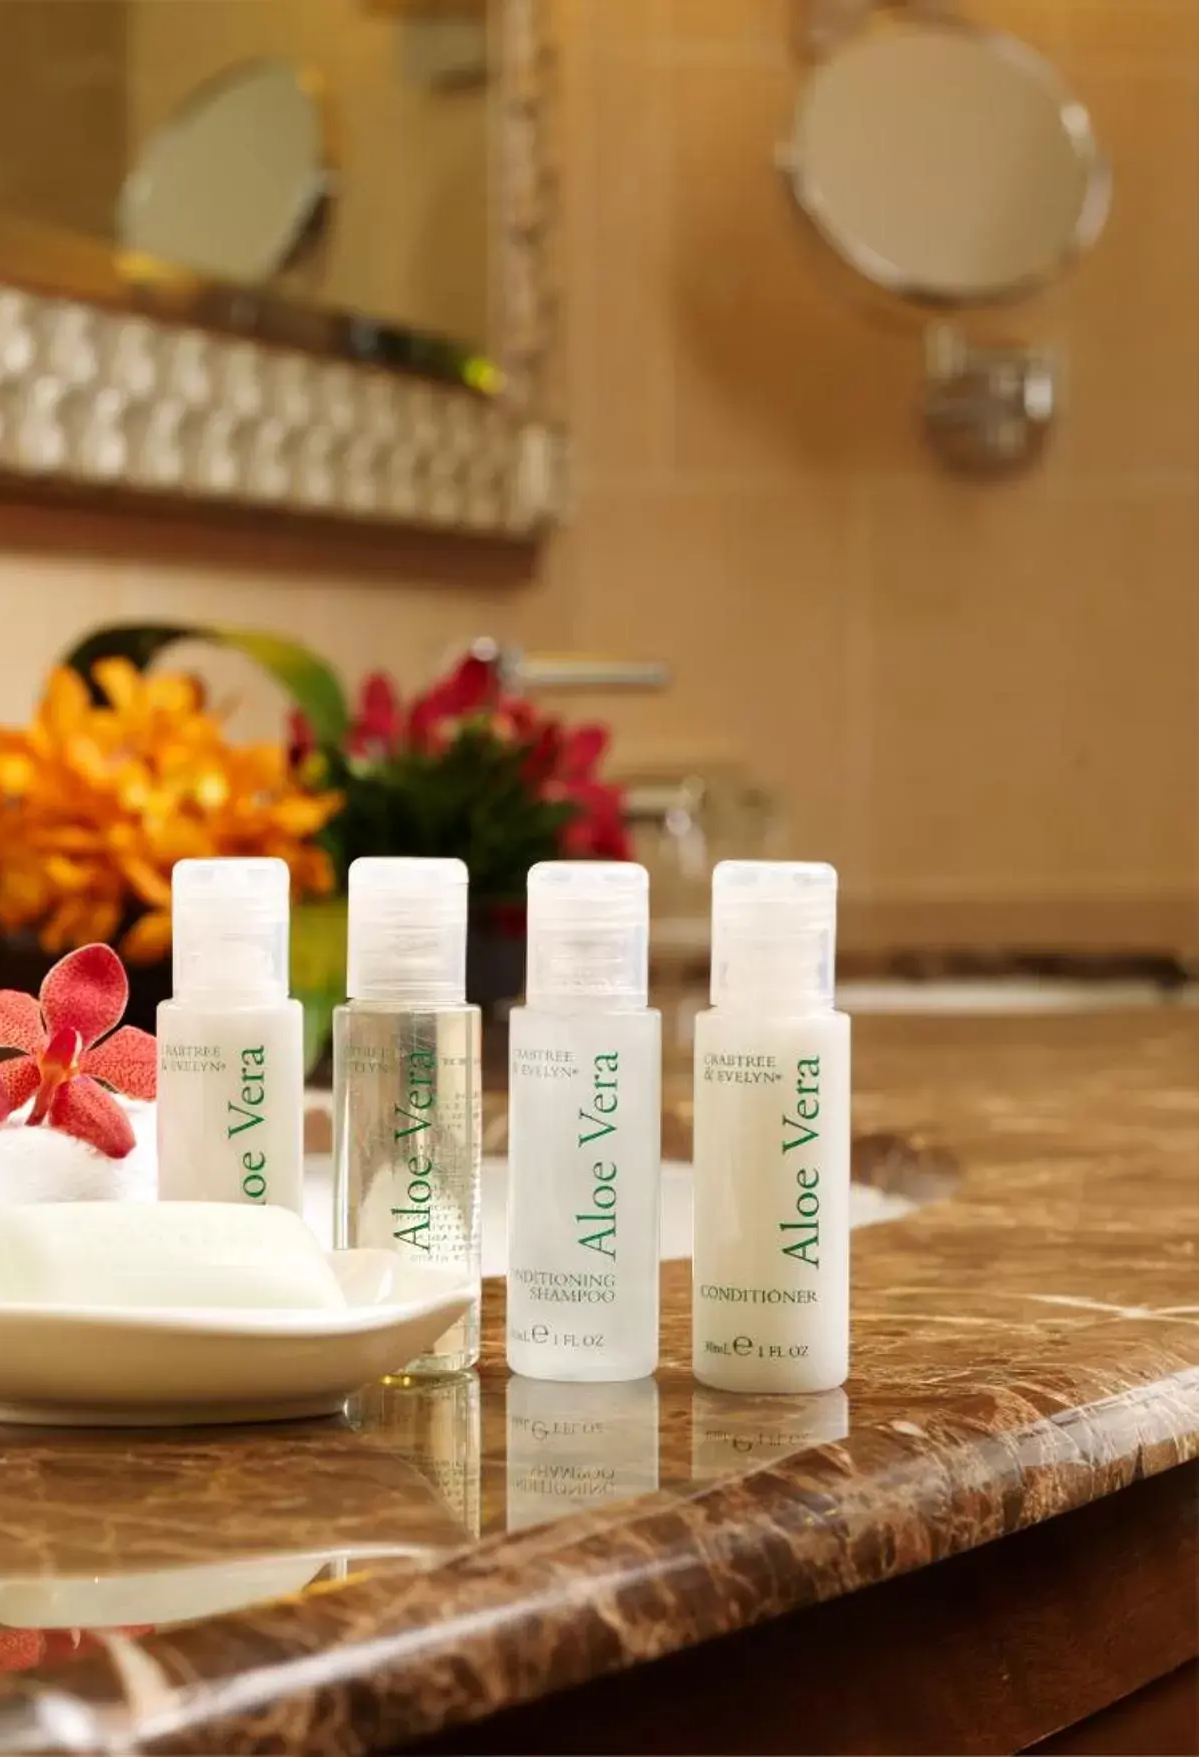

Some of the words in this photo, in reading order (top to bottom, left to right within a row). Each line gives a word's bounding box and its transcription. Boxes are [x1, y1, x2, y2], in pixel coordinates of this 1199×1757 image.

[227, 1045, 266, 1140] Vera
[394, 1047, 435, 1145] Vera
[578, 1051, 619, 1148] Vera
[781, 1054, 821, 1155] Vera
[242, 1151, 267, 1206] oe
[391, 1157, 432, 1253] Aloe
[575, 1161, 618, 1264] Aloe
[779, 1167, 820, 1270] Aloe
[512, 1268, 616, 1288] NDITIONING
[529, 1286, 615, 1304] SHAMPOO
[700, 1284, 818, 1304] CONDITIONER
[563, 1334, 580, 1347] FL
[583, 1334, 605, 1347] OZ
[769, 1345, 786, 1358] FL
[789, 1345, 811, 1358] OZ
